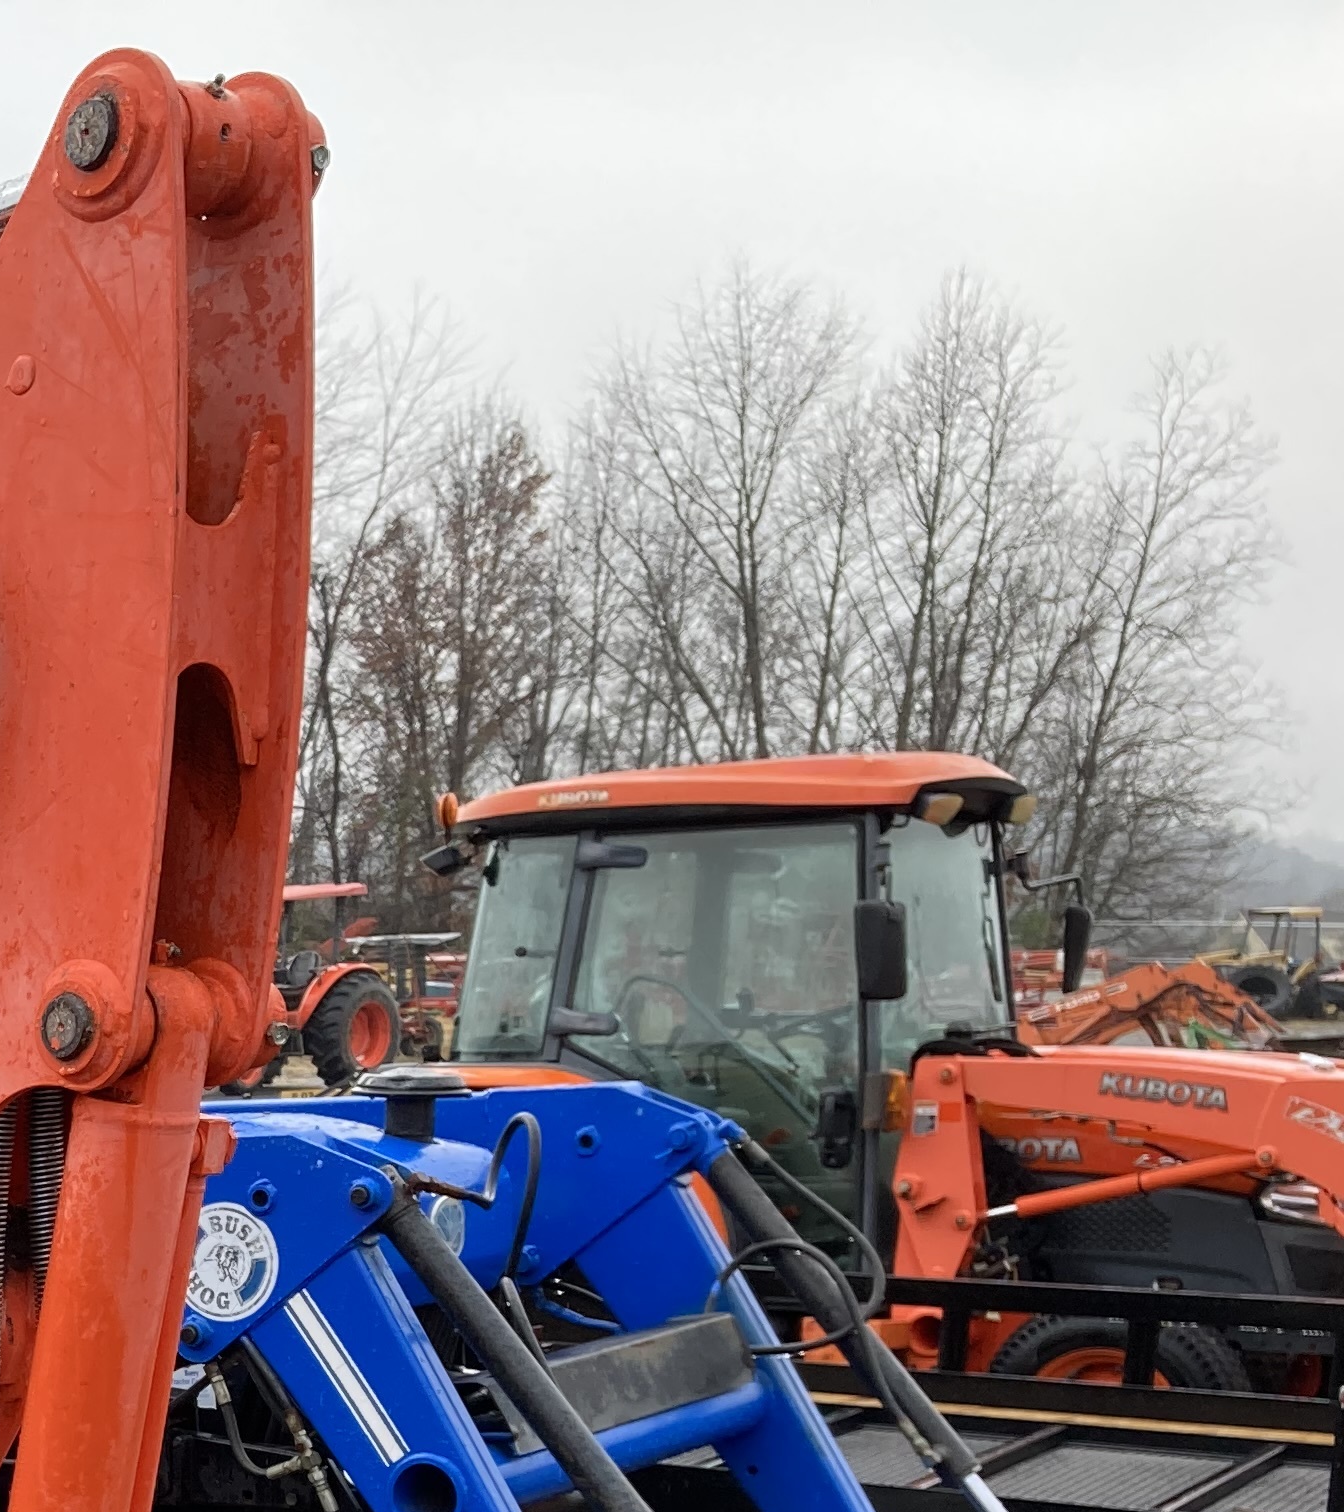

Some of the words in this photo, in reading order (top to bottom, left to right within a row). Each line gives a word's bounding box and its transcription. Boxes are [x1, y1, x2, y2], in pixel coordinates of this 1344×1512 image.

[1099, 1071, 1229, 1113] KUBOTA
[208, 1215, 264, 1257] BUSH
[189, 1271, 231, 1310] HOG
